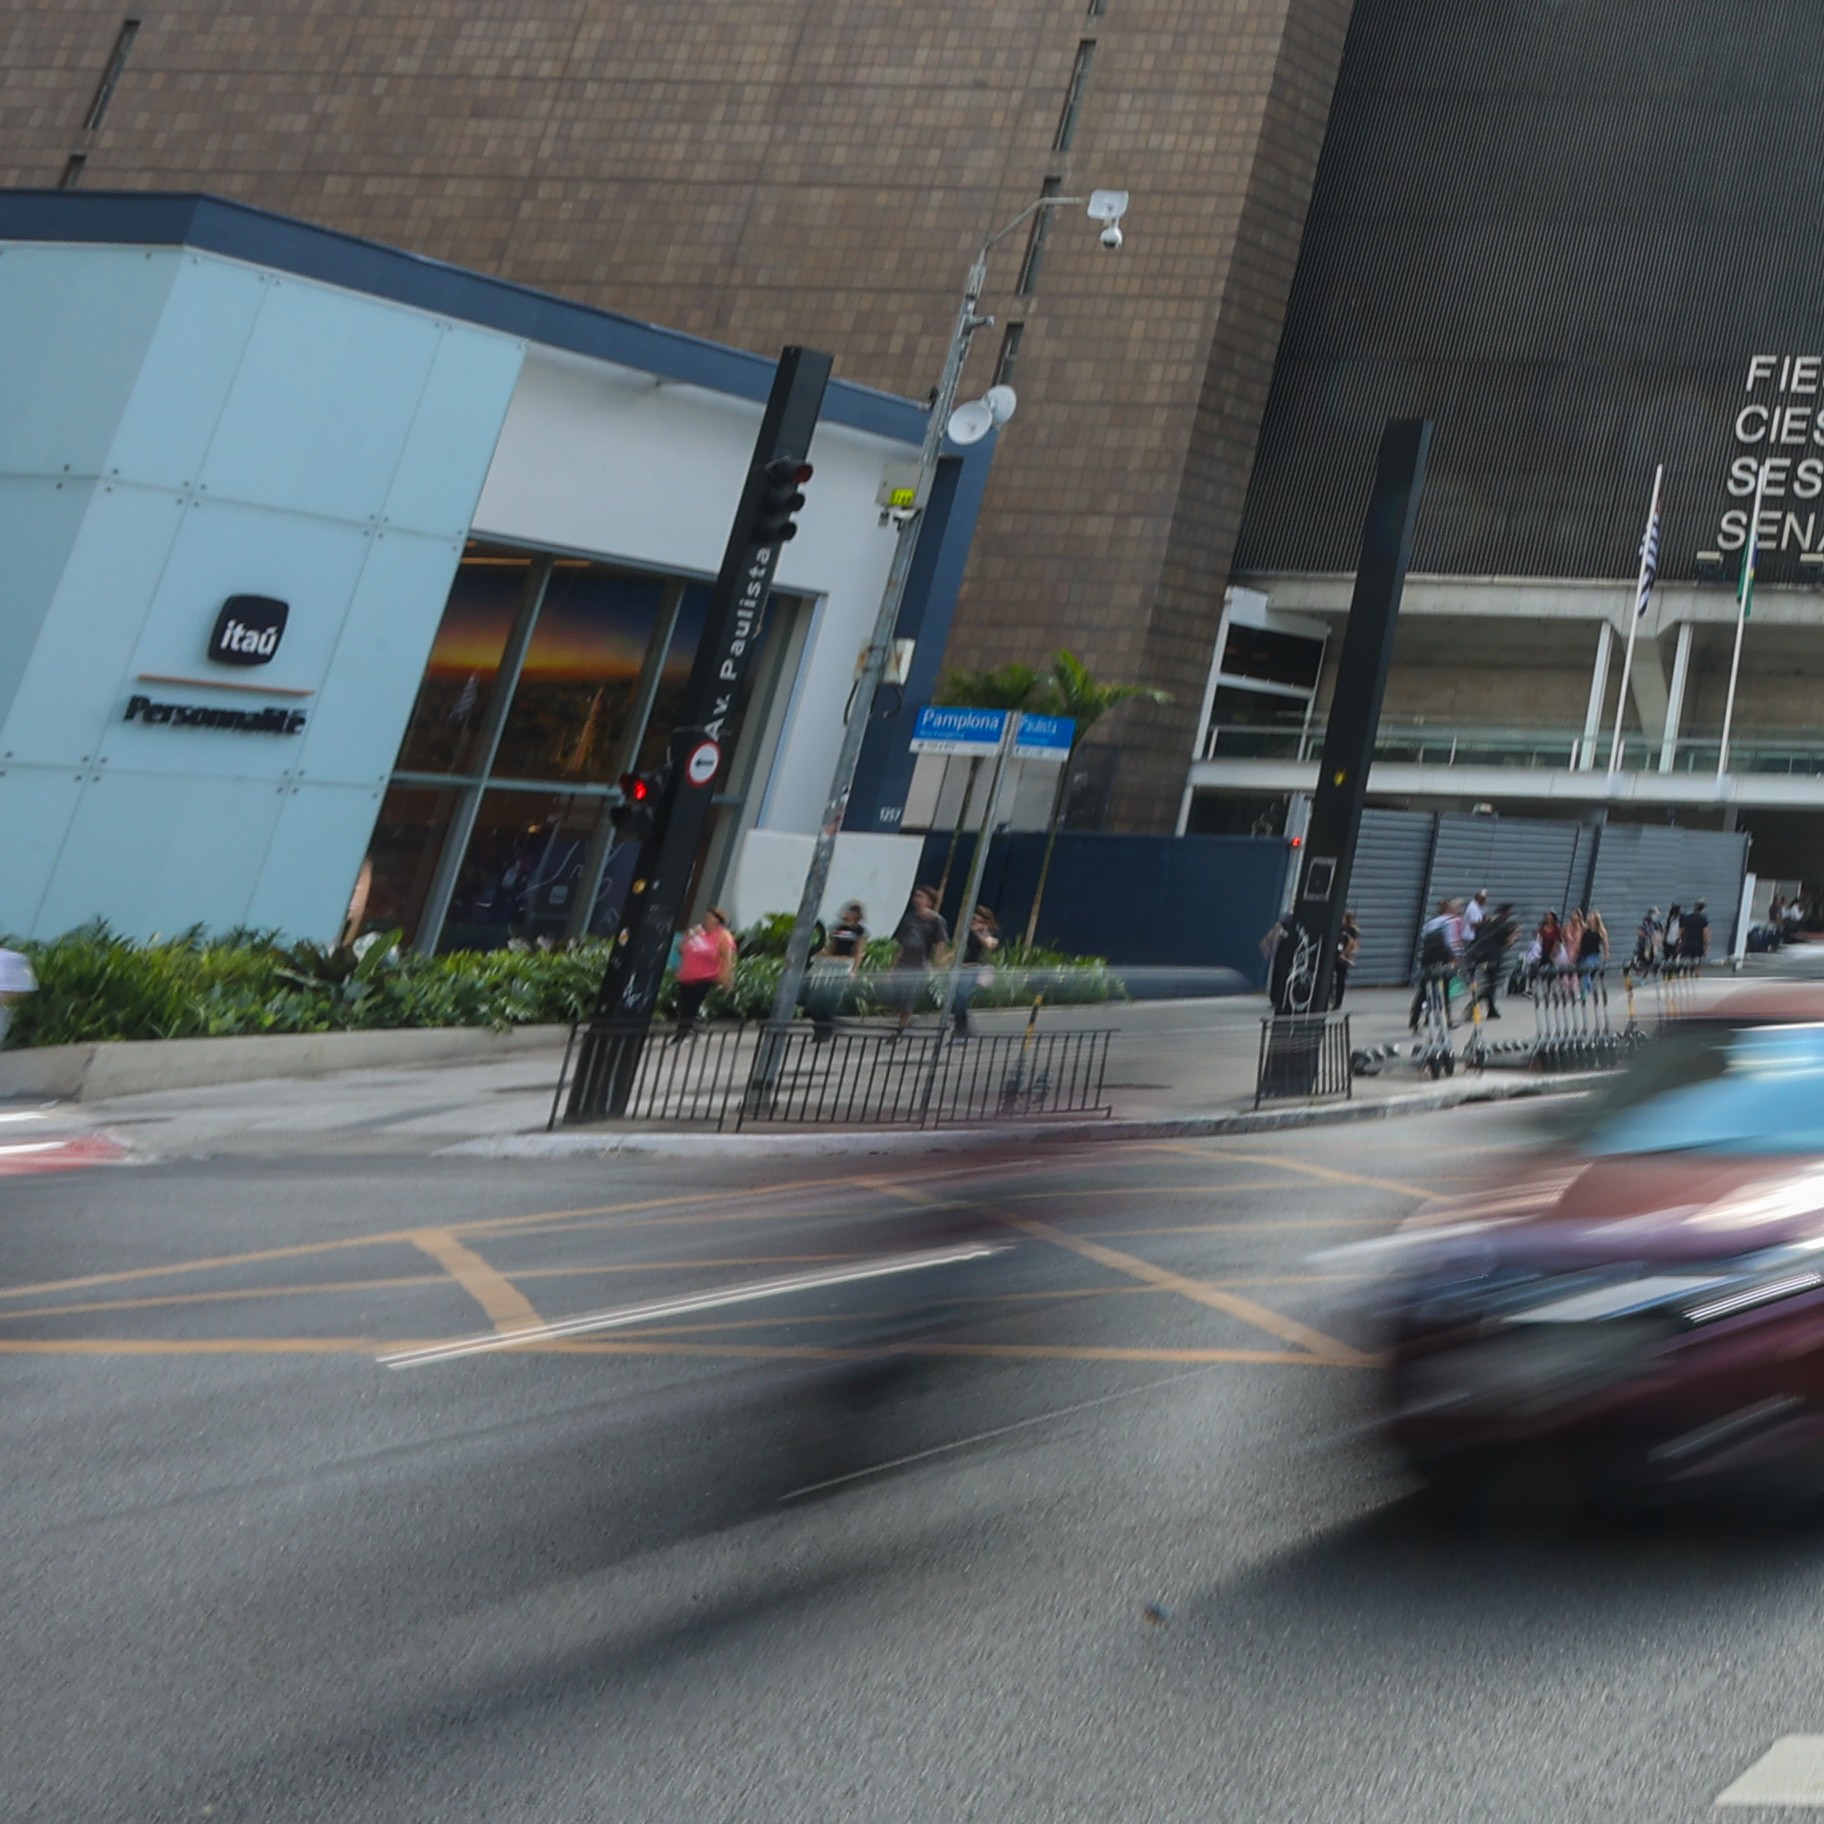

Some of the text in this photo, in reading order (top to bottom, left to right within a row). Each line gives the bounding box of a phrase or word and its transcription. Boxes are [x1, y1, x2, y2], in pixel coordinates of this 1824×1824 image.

[220, 618, 278, 655] itaú
[703, 546, 771, 742] Av. Paulista
[922, 708, 1000, 733] Pamplona
